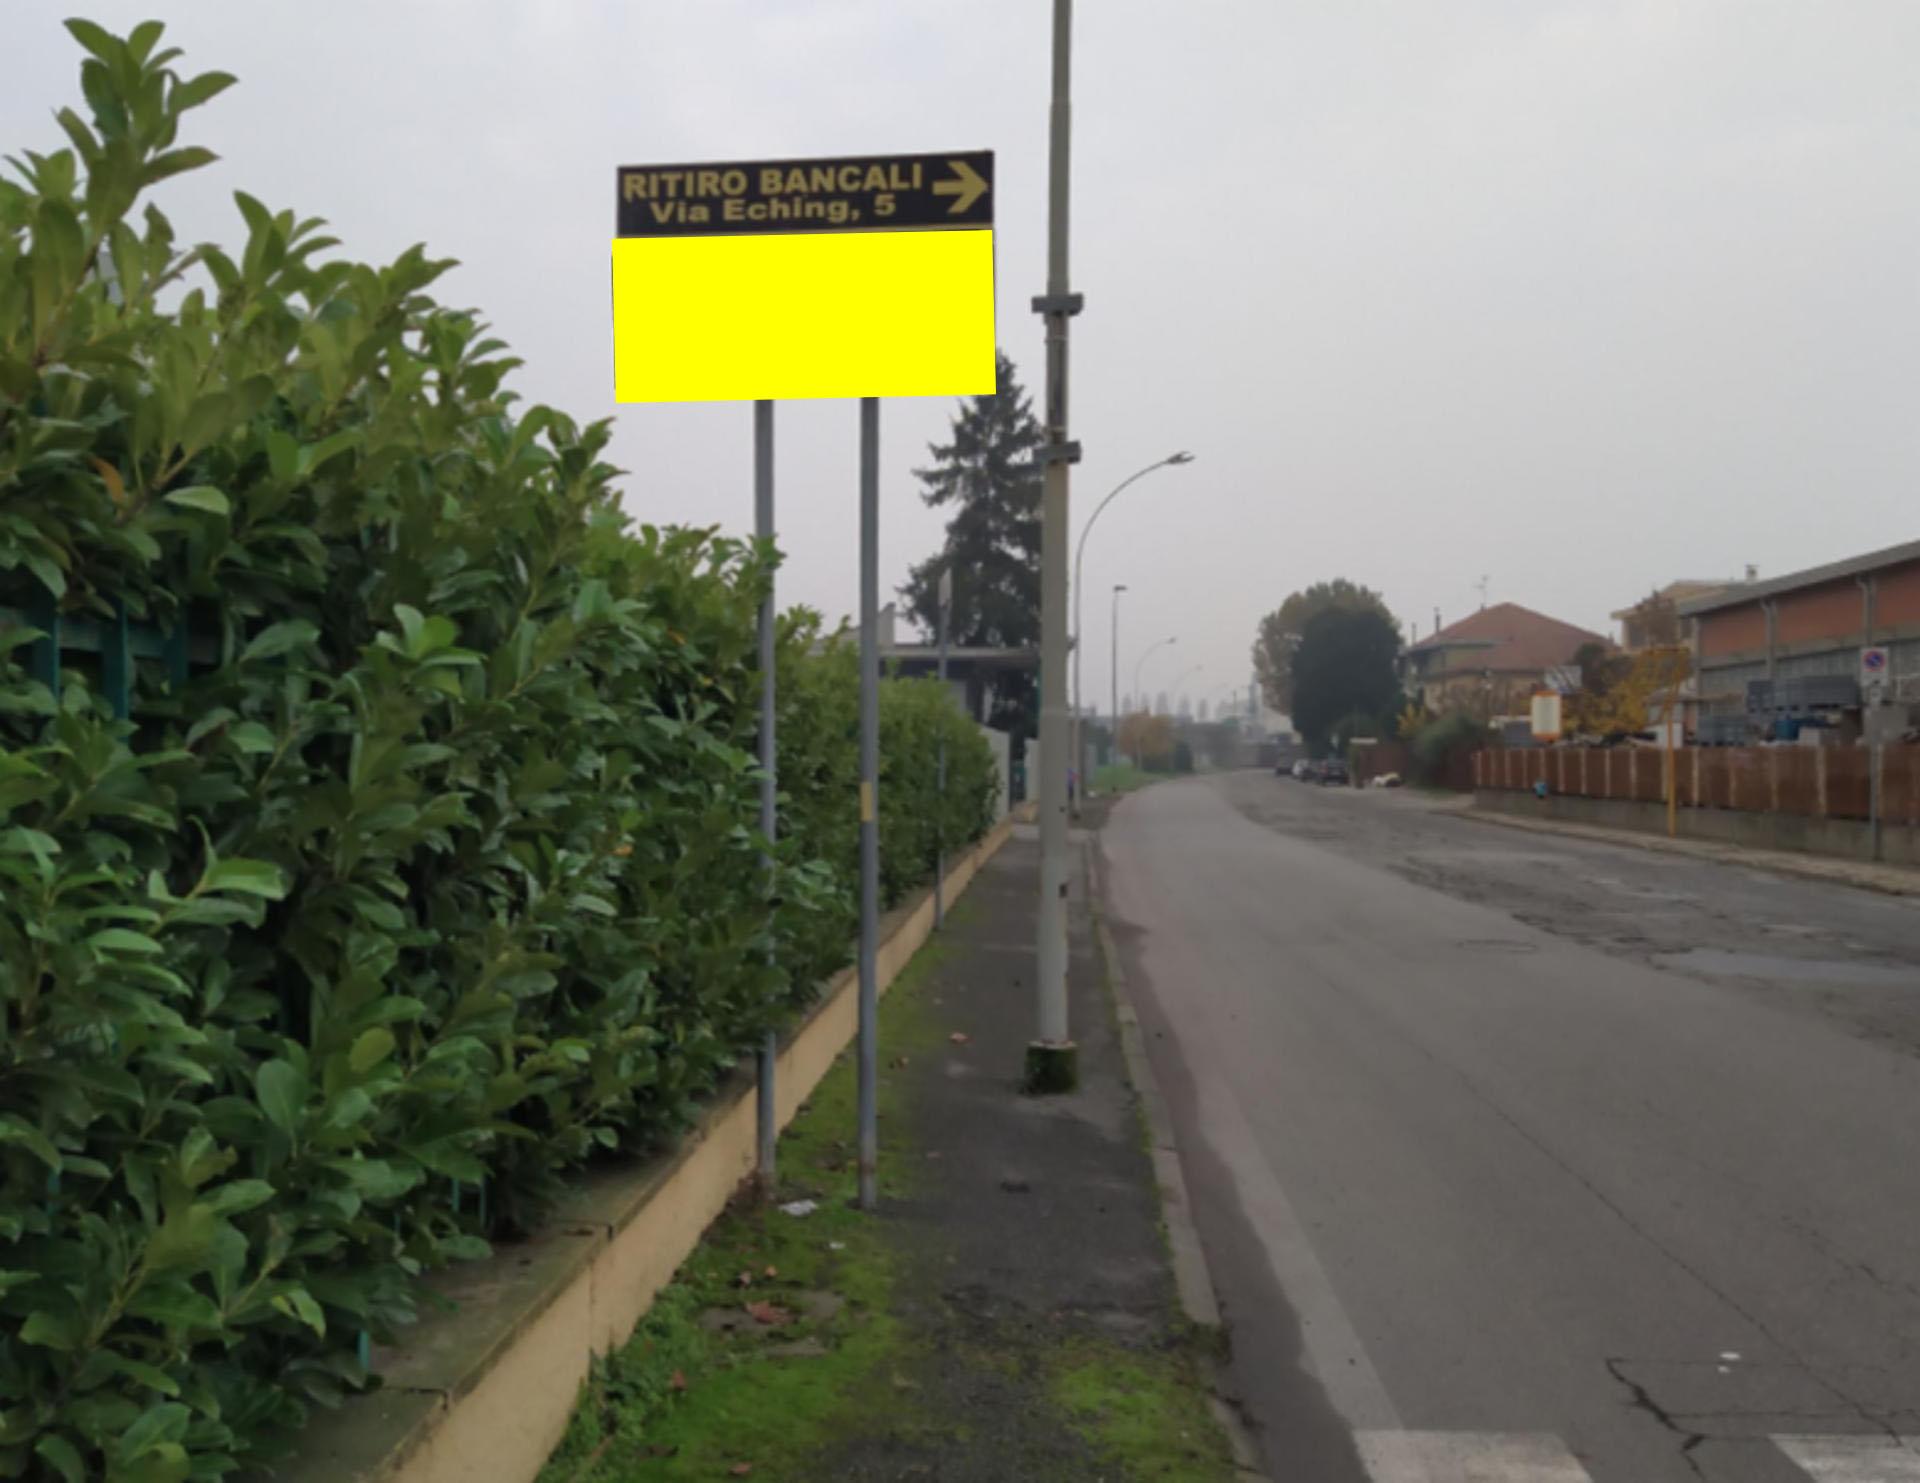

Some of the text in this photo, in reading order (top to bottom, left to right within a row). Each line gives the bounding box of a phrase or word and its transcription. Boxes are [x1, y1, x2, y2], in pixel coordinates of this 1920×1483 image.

[623, 163, 922, 199] RITIRO BANCALI
[651, 193, 896, 223] Via Eching, 5
